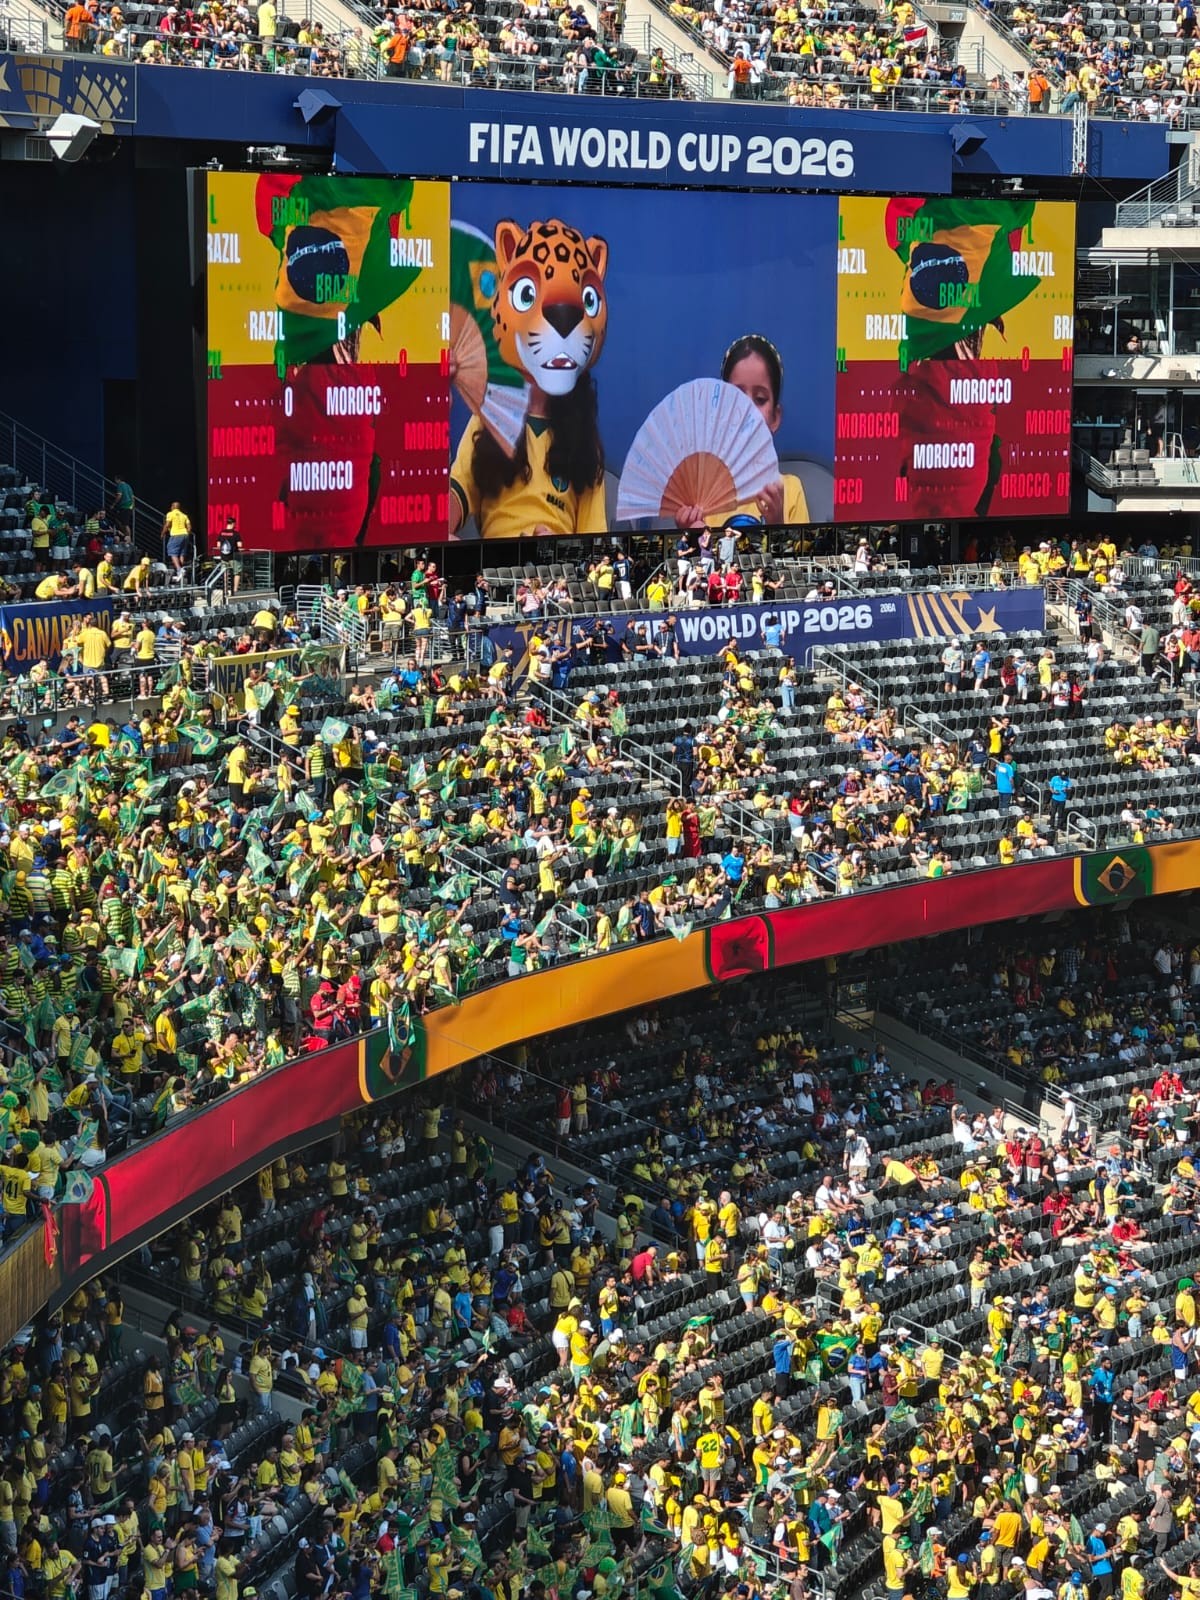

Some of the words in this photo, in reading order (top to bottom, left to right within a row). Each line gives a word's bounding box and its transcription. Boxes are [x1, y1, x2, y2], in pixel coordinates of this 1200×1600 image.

[469, 122, 544, 165] FIFA
[549, 126, 671, 170] WORLD
[677, 133, 741, 173] CUP
[746, 135, 854, 177] 2026
[390, 238, 433, 267] BRAZIL
[1012, 251, 1055, 277] BRAZIL
[316, 273, 359, 303] BRAZIL
[939, 282, 981, 308] BRAZIL
[249, 311, 286, 341] RAZIL
[337, 311, 346, 341] B
[865, 314, 908, 341] BRAZIL
[950, 378, 1011, 405] MOROCCO
[838, 412, 899, 439] MOROCCO
[213, 426, 275, 457] MOROCCO
[913, 442, 975, 469] MOROCCO
[290, 460, 353, 492] MOROCCO
[680, 614, 757, 642] WORLD
[803, 604, 873, 633] 2026
[6, 1180, 18, 1199] 41
[702, 1439, 718, 1453] 22
